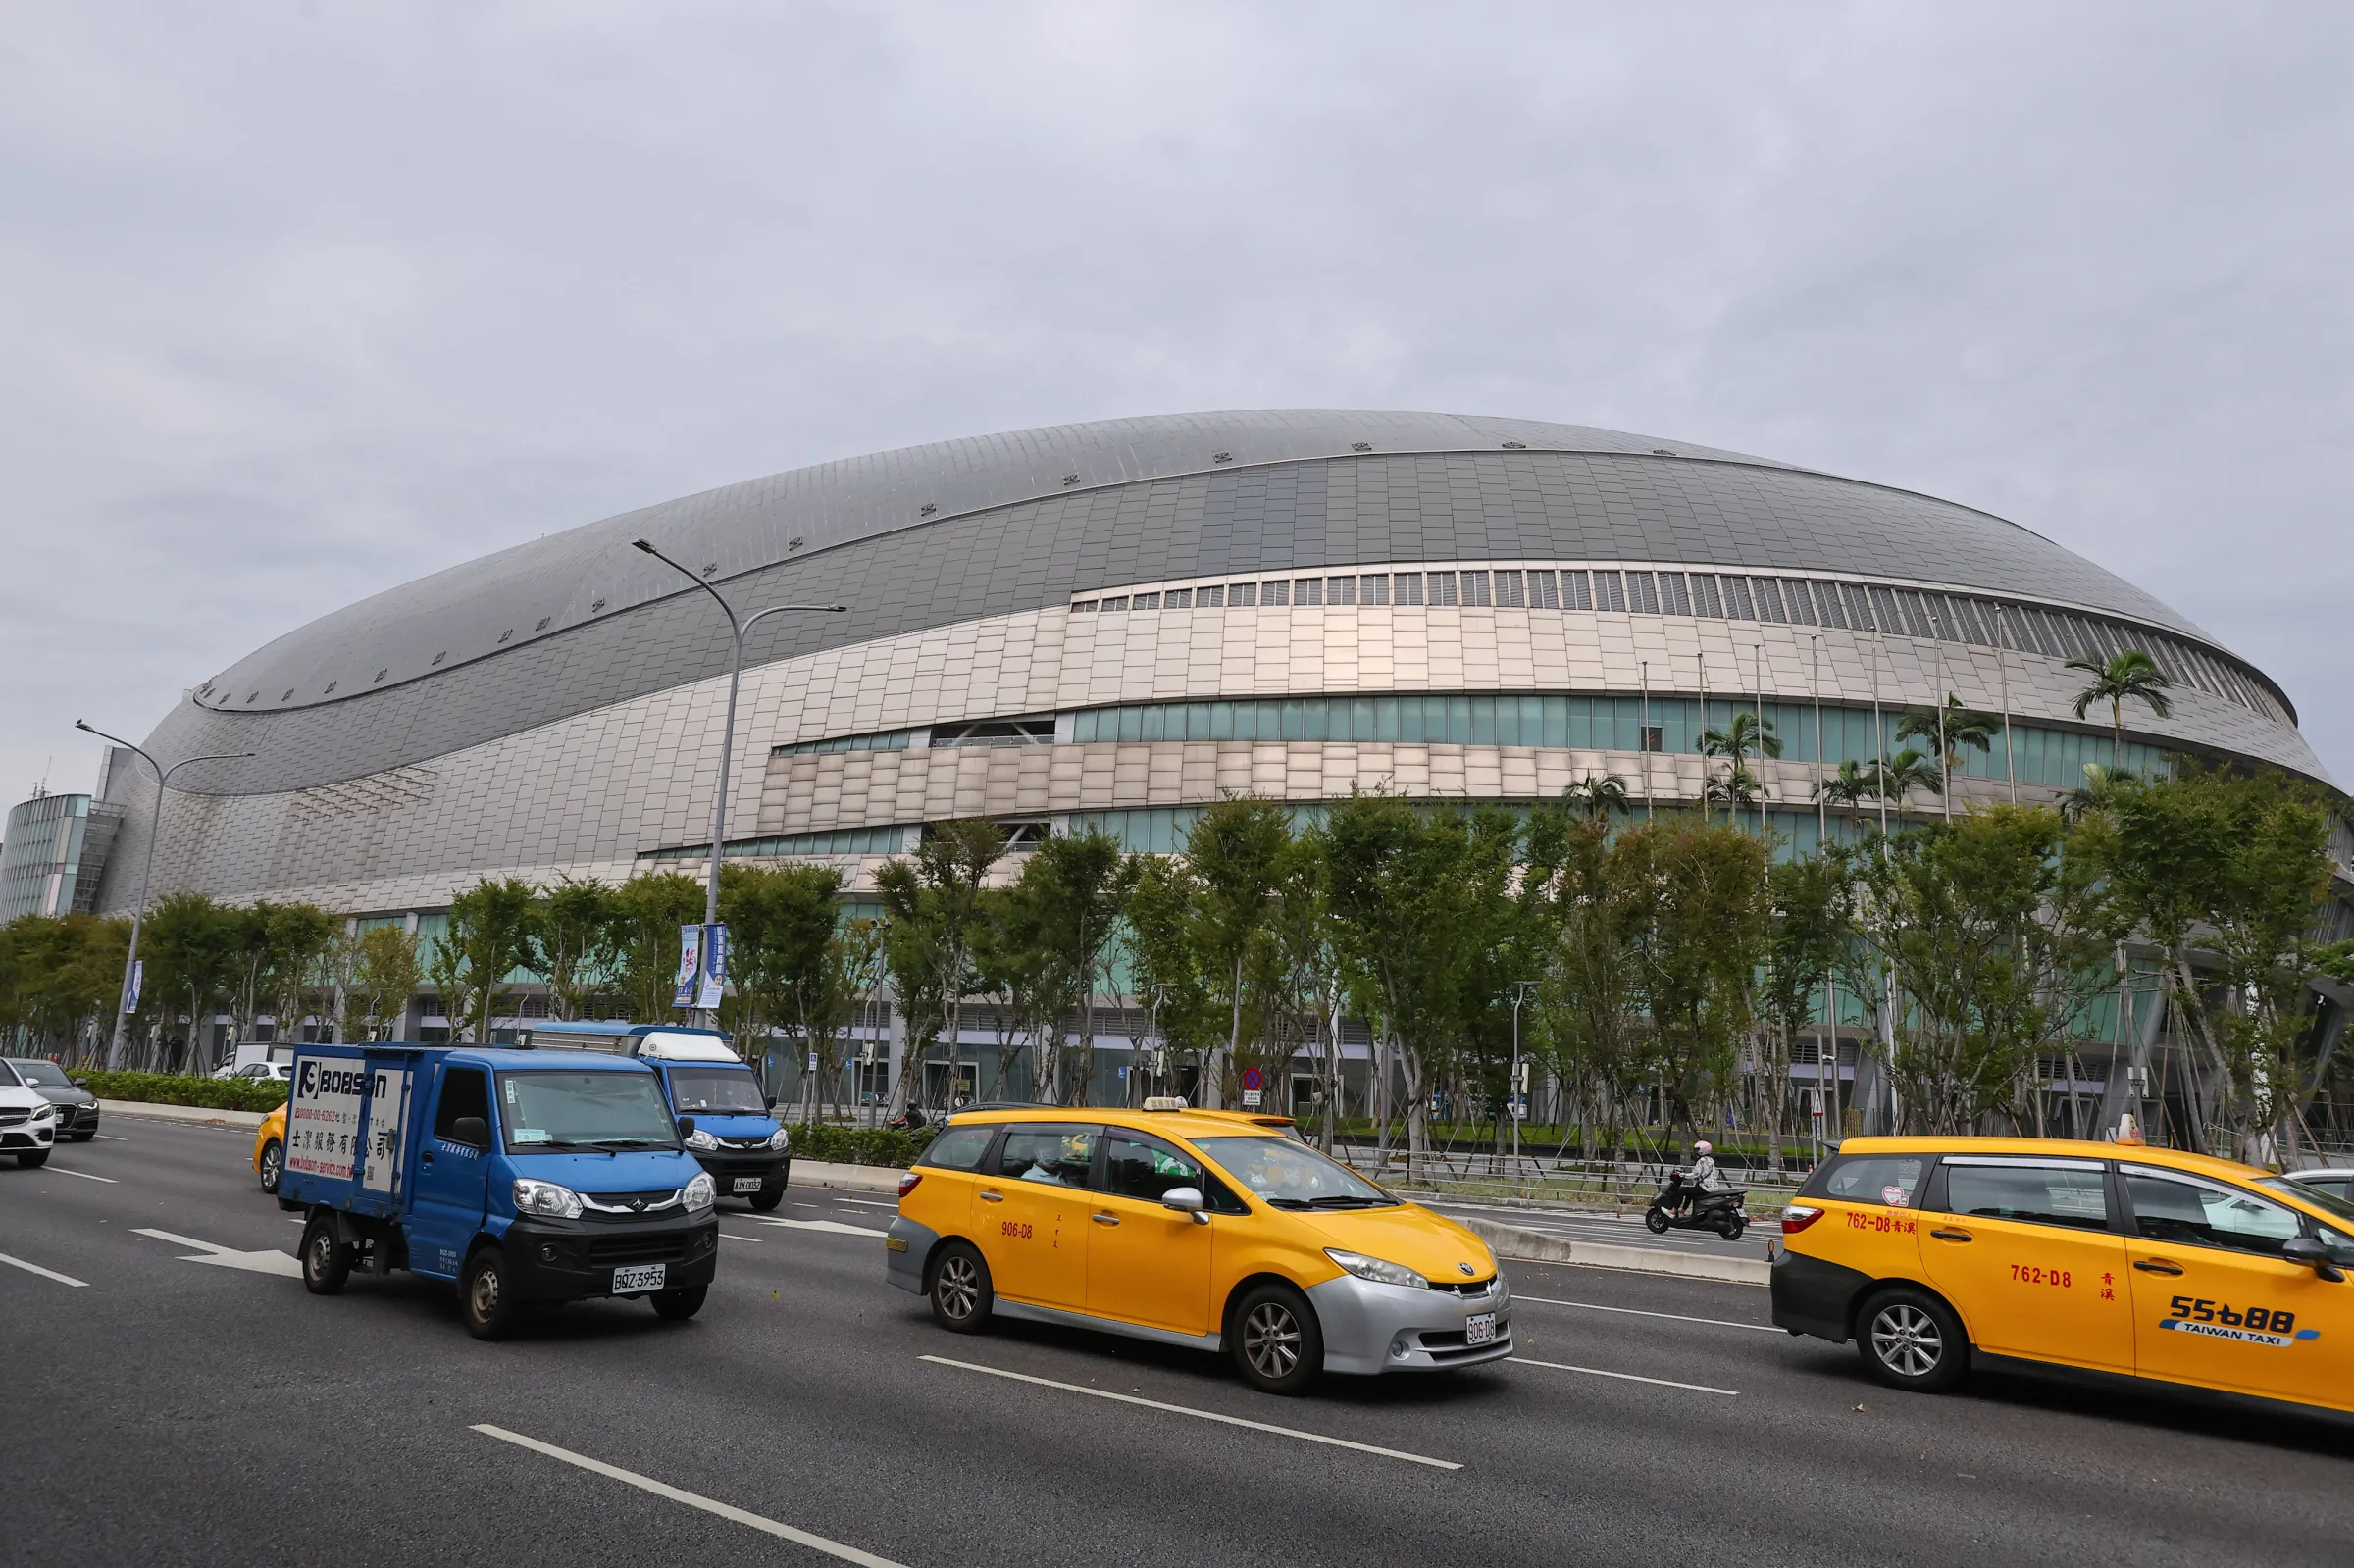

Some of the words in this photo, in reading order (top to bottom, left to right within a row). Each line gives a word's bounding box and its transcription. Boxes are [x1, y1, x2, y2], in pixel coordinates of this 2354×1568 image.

[1002, 1221, 1033, 1239] 906-D8
[1847, 1212, 1891, 1233] 762-D8
[614, 1270, 663, 1290] BQZ-3953
[2011, 1264, 2071, 1288] 762-D8
[2170, 1295, 2295, 1334] 55688
[1468, 1320, 1495, 1340] 906-D8
[2184, 1323, 2243, 1340] TAIWAN
[2247, 1333, 2281, 1345] TAXI
